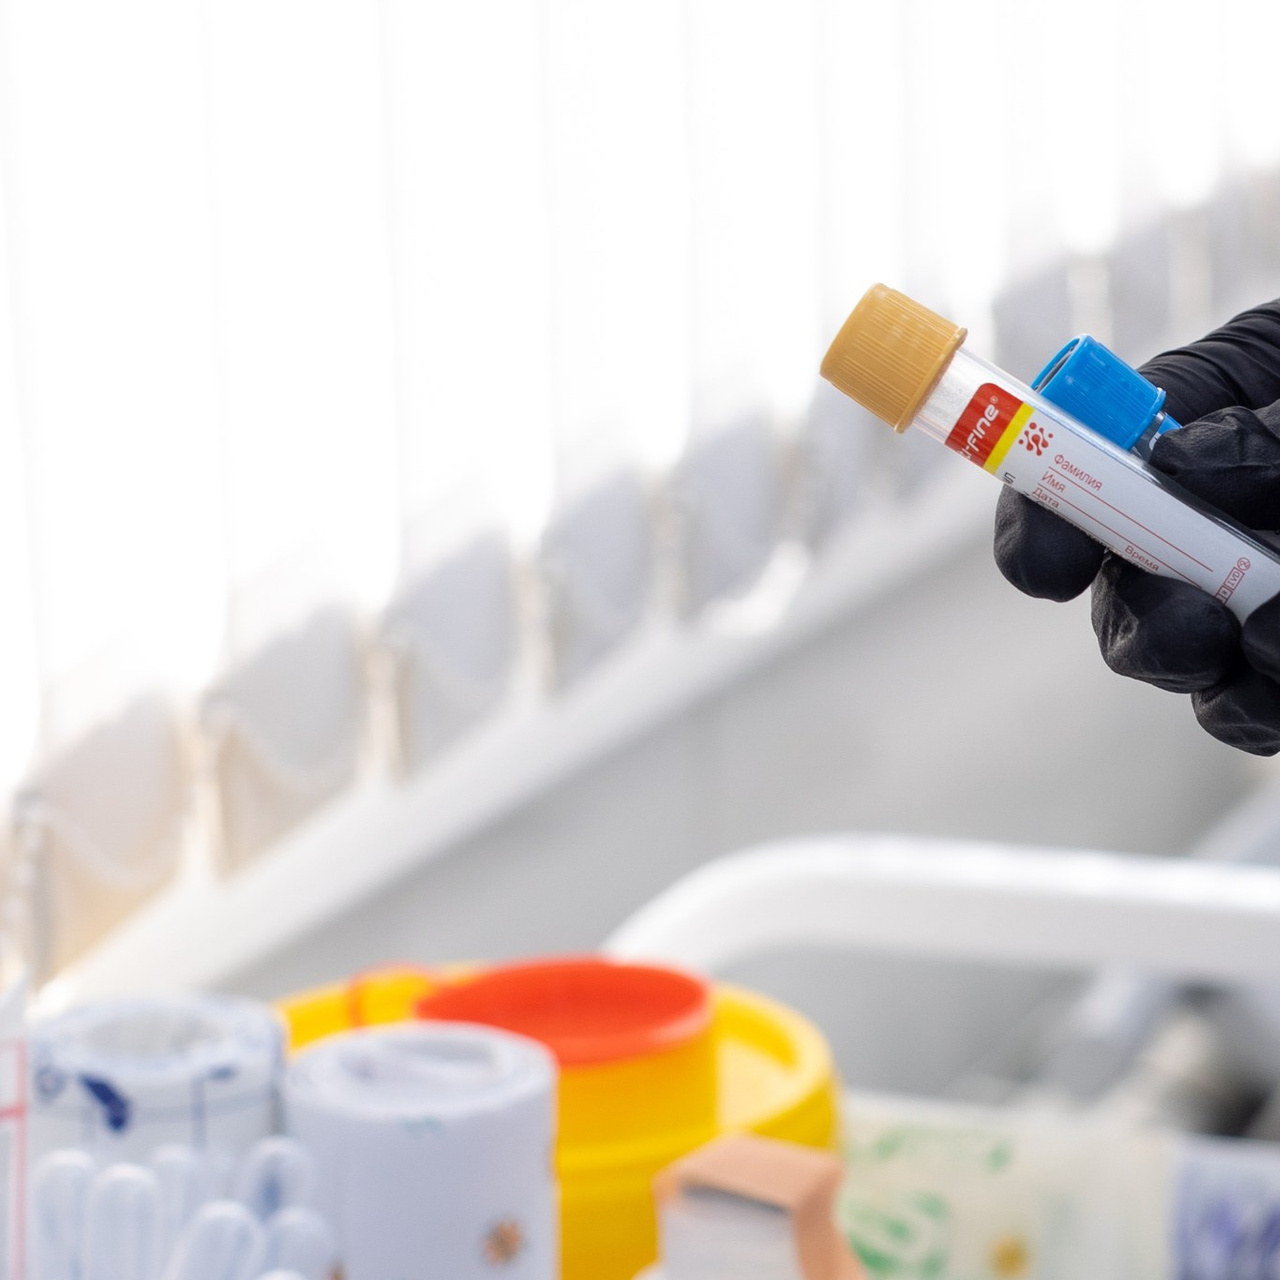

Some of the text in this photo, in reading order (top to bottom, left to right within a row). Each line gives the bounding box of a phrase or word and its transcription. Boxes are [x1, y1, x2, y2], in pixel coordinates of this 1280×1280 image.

[1041, 471, 1066, 492] Имя
[1054, 454, 1103, 491] Фамилия
[1032, 487, 1060, 508] Дата
[1124, 545, 1160, 571] Время
[1226, 569, 1242, 588] IVD
